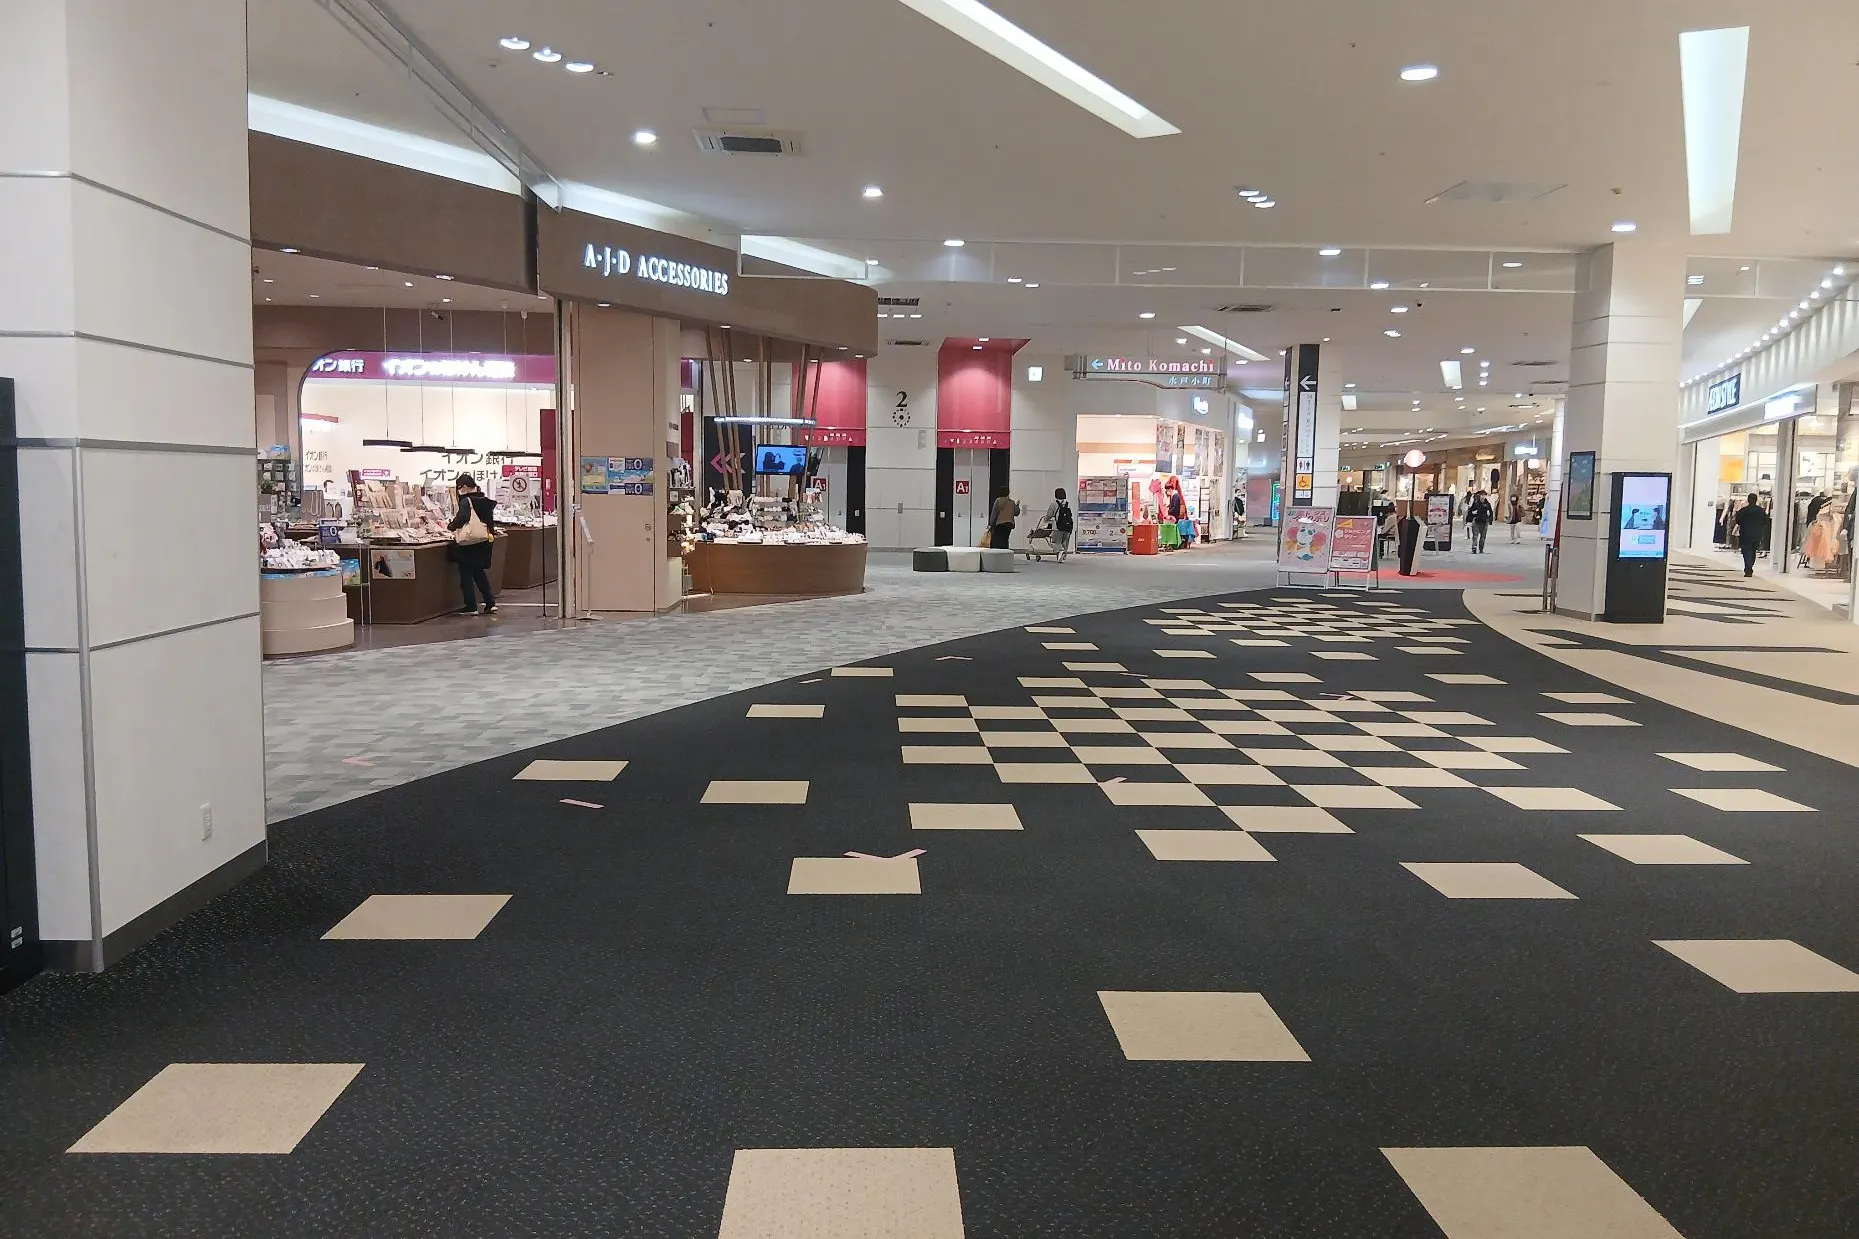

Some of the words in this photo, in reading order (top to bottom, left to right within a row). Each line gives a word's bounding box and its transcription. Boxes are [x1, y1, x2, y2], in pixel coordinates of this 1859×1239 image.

[637, 254, 729, 296] ACCESSORIES
[1107, 358, 1142, 371] Mito
[1148, 358, 1215, 372] Komachi
[1168, 375, 1212, 386] 水戸小町
[895, 390, 908, 408] 2
[815, 479, 826, 491] A1
[956, 481, 969, 494] A1
